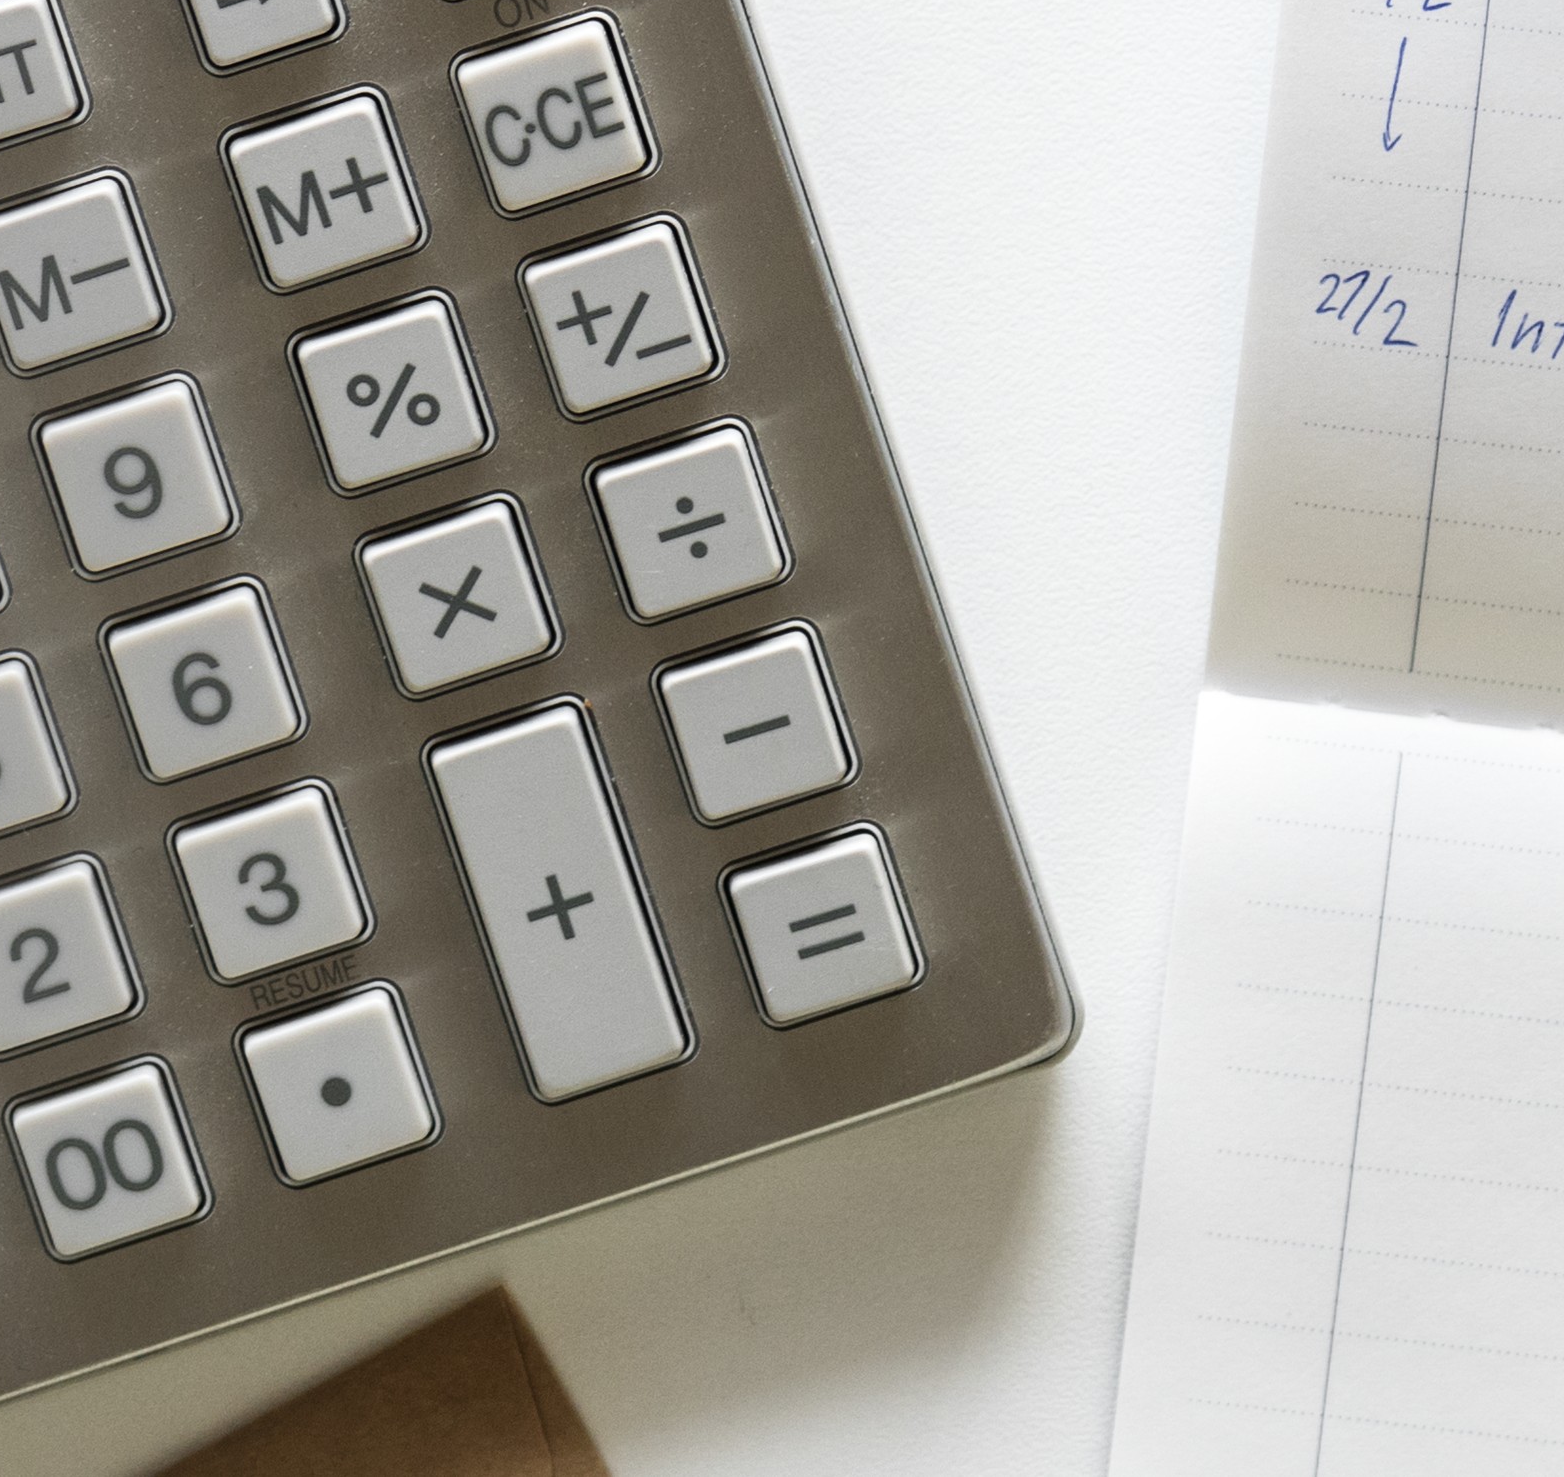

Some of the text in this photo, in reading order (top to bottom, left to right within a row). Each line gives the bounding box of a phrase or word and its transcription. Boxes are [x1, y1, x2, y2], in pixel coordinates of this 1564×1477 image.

[255, 157, 390, 246] M+
[104, 447, 163, 519] 9
[172, 652, 232, 726] 6
[238, 852, 300, 926] 3
[10, 928, 71, 1004] 2
[249, 954, 362, 1011] RESUME
[45, 1119, 164, 1211] 00
